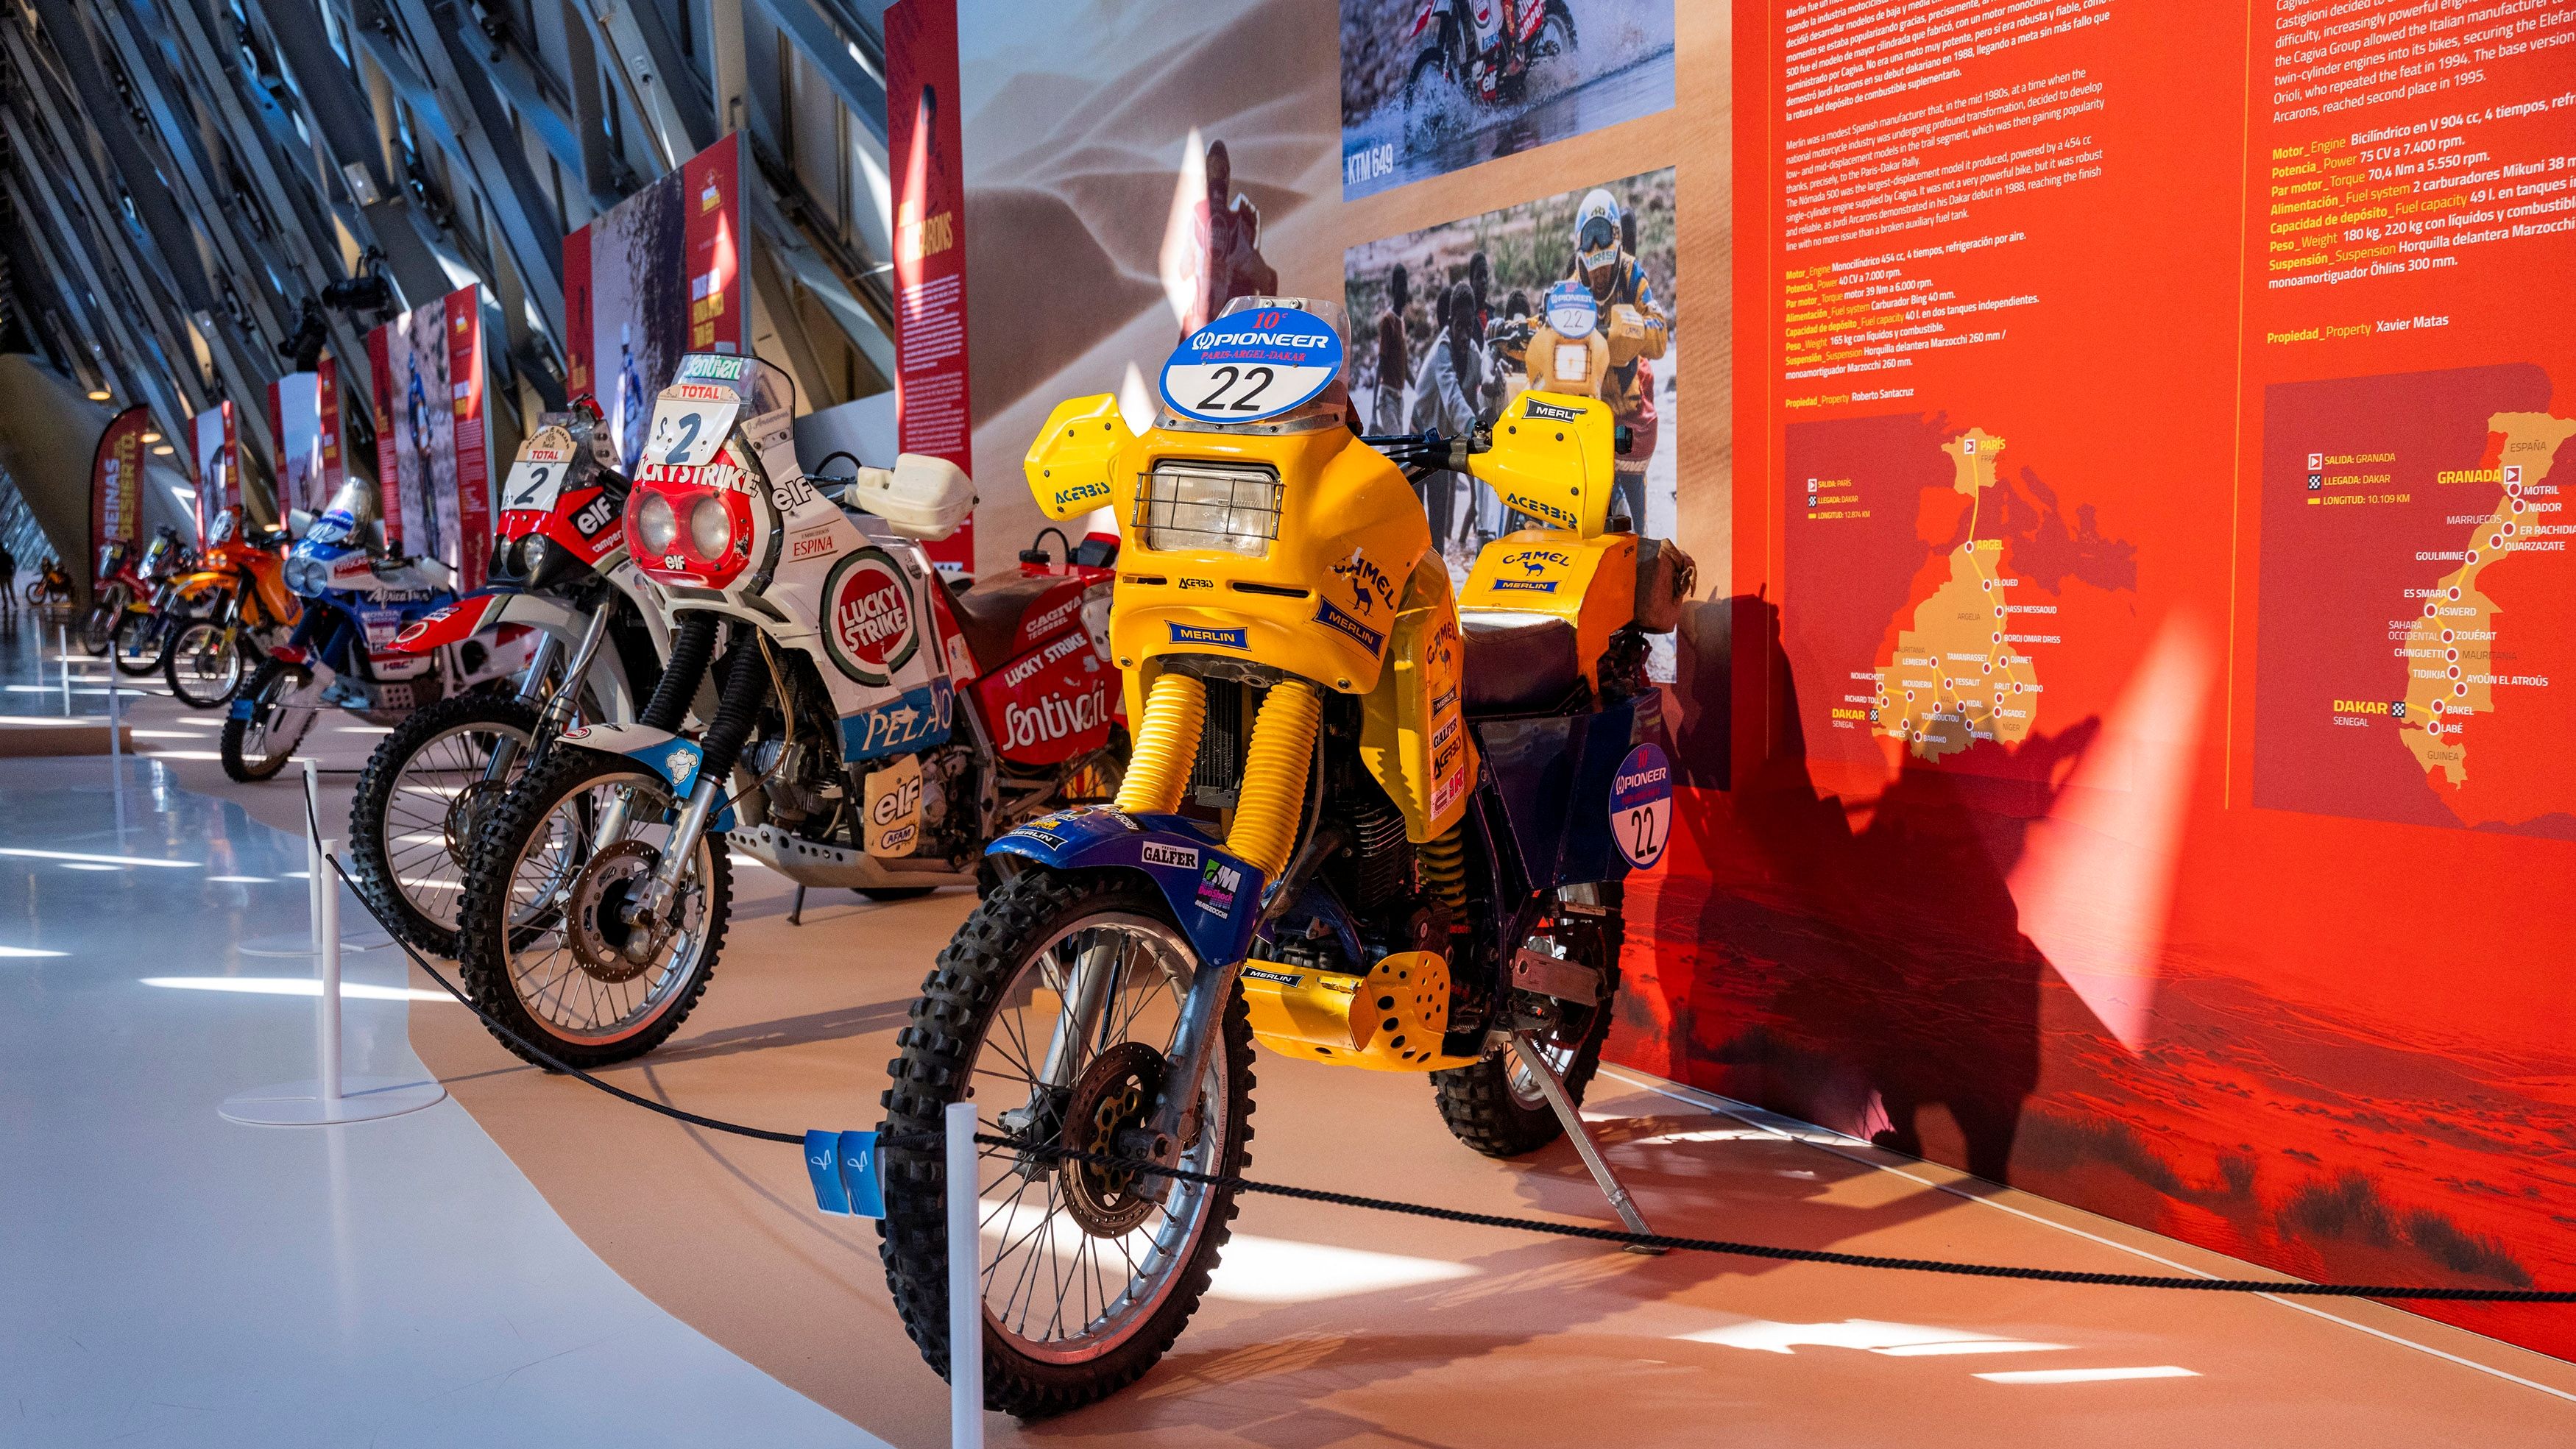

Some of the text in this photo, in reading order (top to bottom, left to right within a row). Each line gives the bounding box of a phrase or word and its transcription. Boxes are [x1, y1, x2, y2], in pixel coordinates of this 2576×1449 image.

[1786, 68, 1961, 121] la rotura del depósito de combustible suplementario.
[2274, 69, 2486, 123] Arcarons, reached second place in 1995.
[1348, 144, 1393, 185] KTM 649
[1786, 231, 2026, 279] Motor_Engine Monocilíndrico 454 cc, 4 tiempos, refrigeración por aire.
[2269, 256, 2458, 288] monoamortiguador Öhlins 300 mm.
[1563, 310, 1583, 328] 22
[2268, 316, 2449, 344] Propiedad_Property Xavier Matas
[1214, 333, 1328, 349] PIONEER
[1201, 350, 1306, 361] PARIS-ARGEL-DAKAR
[682, 385, 719, 400] TOTAL
[1196, 366, 1274, 411] 22
[1786, 388, 1914, 408] Propiedad_Property Roberto Santacruz
[1535, 405, 1580, 419] MERLI
[665, 412, 701, 464] 2
[1981, 439, 2006, 450] PARÍS
[2510, 440, 2547, 452] ESPAÑA
[531, 450, 559, 460] TOTAL
[2324, 453, 2396, 466] SALIDA: GRANADA
[1837, 478, 1852, 487] PARÍS
[2324, 474, 2391, 486] LLEGADA: DAKAR
[2438, 470, 2502, 483] GRANADA
[514, 467, 549, 505] 2
[2524, 485, 2559, 495] MOTRIL
[771, 475, 813, 511] elf
[1818, 495, 1858, 504] LLEGADA: DAKAR
[2324, 494, 2410, 506] LONGITUD: 10.109 KM
[2528, 502, 2562, 512] NADOR
[577, 496, 612, 534] elf
[2447, 515, 2502, 525] MARRUECOS
[2520, 525, 2533, 535] ER
[592, 529, 622, 553] camper
[793, 536, 833, 556] ESPINA
[1977, 540, 2004, 550] ARGEL
[2505, 541, 2565, 551] OUARZAZATE
[1502, 551, 1569, 567] CAMEL
[2416, 551, 2464, 561] GOULIMINE
[665, 555, 685, 570] elf
[2002, 578, 2018, 587] OUED
[2405, 589, 2447, 598] ES SMARA
[841, 585, 899, 628] LUCKY
[2006, 606, 2056, 614] HASSI MESSAOUD
[2438, 606, 2477, 616] ASWERD
[1025, 595, 1082, 633] CAGIVA
[845, 607, 907, 653] STRIKE
[1328, 611, 1374, 645] MERLIN
[2388, 621, 2422, 630] SAHARA
[1181, 628, 1235, 642] MERLIN
[2024, 635, 2041, 643] OMAR
[2042, 635, 2060, 644] DRISS
[2388, 631, 2439, 641] OCCIDENTAL
[2456, 629, 2497, 641] ZOUÉRAT
[1426, 621, 1457, 665] CAMEL
[1947, 653, 1988, 662] TAMANRASSET
[2394, 648, 2444, 658] CHINGUETTI
[1003, 632, 1088, 688] LUCKY STRIKE
[2011, 656, 2032, 664] DJANET
[1851, 672, 1885, 681] NOUAKCHOTT
[2413, 669, 2446, 679] TIDJIKJA
[2467, 673, 2548, 687] AYOÛN EL ATROÛS
[1903, 680, 1932, 688] MOUDJERIA
[1956, 678, 1980, 686] TESSALIT
[1995, 682, 2011, 690] ARLIT
[2025, 684, 2043, 692] DJADO
[1437, 690, 1455, 712] MERLIN
[1845, 695, 1880, 704] RICHARD TOLL
[1967, 700, 1983, 708] KIDAL
[2333, 699, 2388, 714] DAKAR
[2446, 706, 2474, 715] BAKEL
[1832, 709, 1865, 719] DAKAR
[2003, 709, 2026, 718] AGADEZ
[861, 689, 952, 751] PELAO
[1833, 720, 1854, 729] SENEGAL
[2334, 716, 2369, 726] SENEGAL
[1433, 718, 1458, 749] GALFER
[2441, 723, 2463, 734] LABÉ
[1923, 734, 1947, 743] BAMAKO
[1971, 731, 1992, 740] NIAMEY
[2427, 751, 2459, 760] GUINEA
[1624, 768, 1666, 790] PIONEER
[874, 775, 920, 826] elf
[888, 829, 911, 844] AFAM
[1008, 830, 1053, 843] MERLIN
[1631, 806, 1657, 859] 22
[1143, 847, 1196, 868] GALFER
[1197, 884, 1234, 902] DuoShock
[1195, 899, 1228, 919] MARZOCCHI
[1250, 971, 1292, 982] MERLIN
